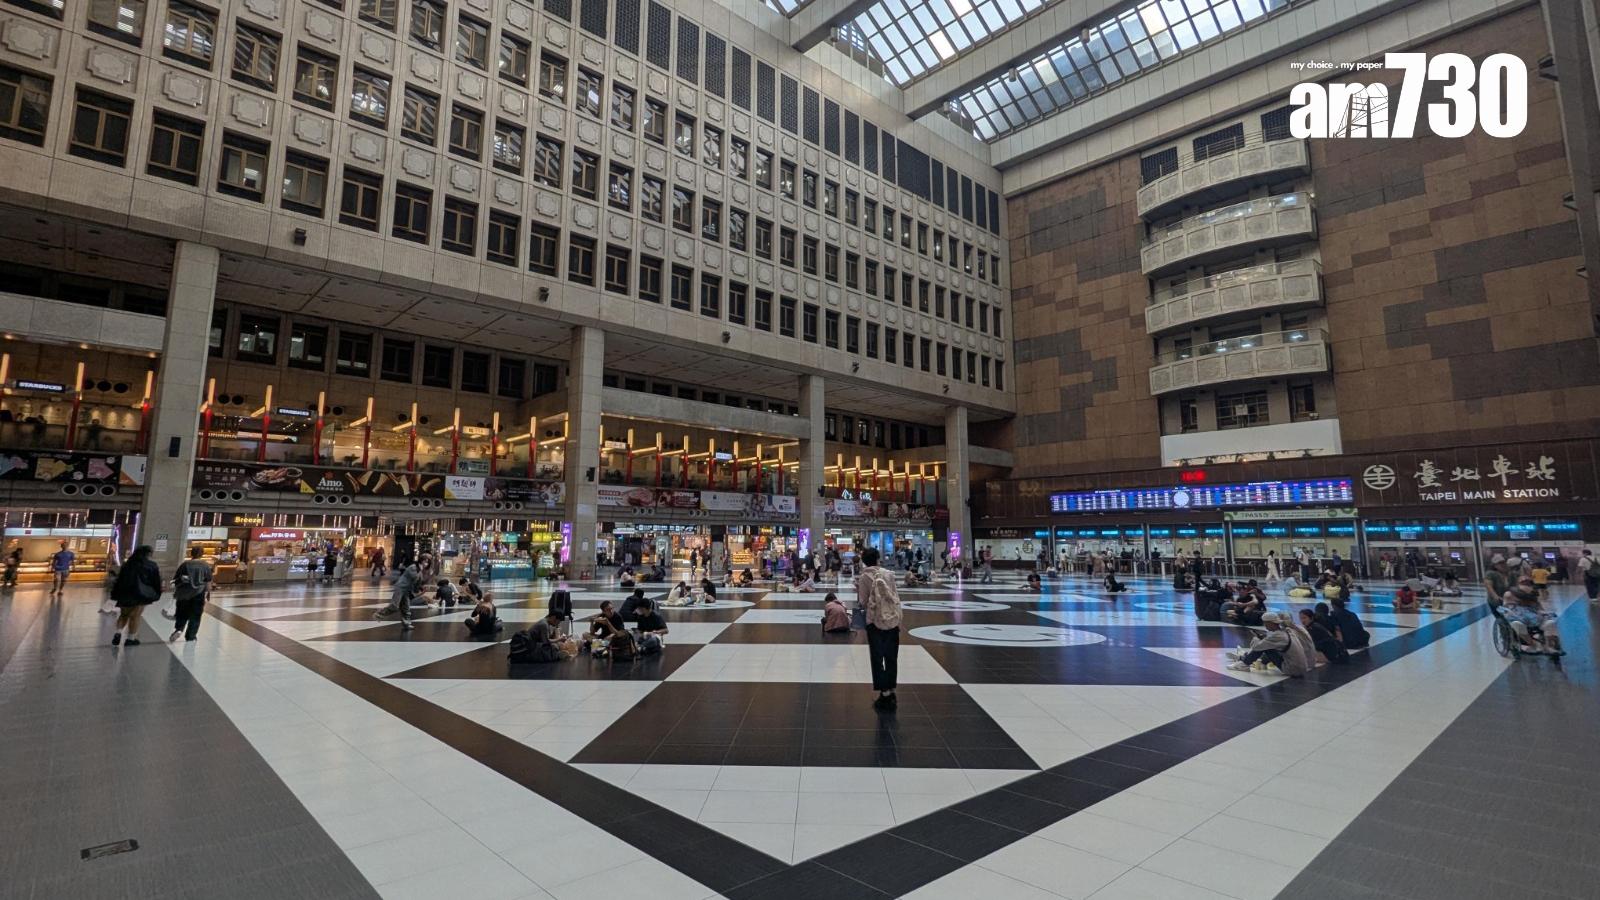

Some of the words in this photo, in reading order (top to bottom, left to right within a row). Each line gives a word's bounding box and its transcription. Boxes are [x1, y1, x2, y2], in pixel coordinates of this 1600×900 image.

[1413, 455, 1556, 488] 臺北車站
[318, 477, 342, 486] Amo
[1419, 491, 1456, 501] TAIPEI
[1463, 490, 1496, 500] MAIN
[1503, 488, 1560, 498] STATION
